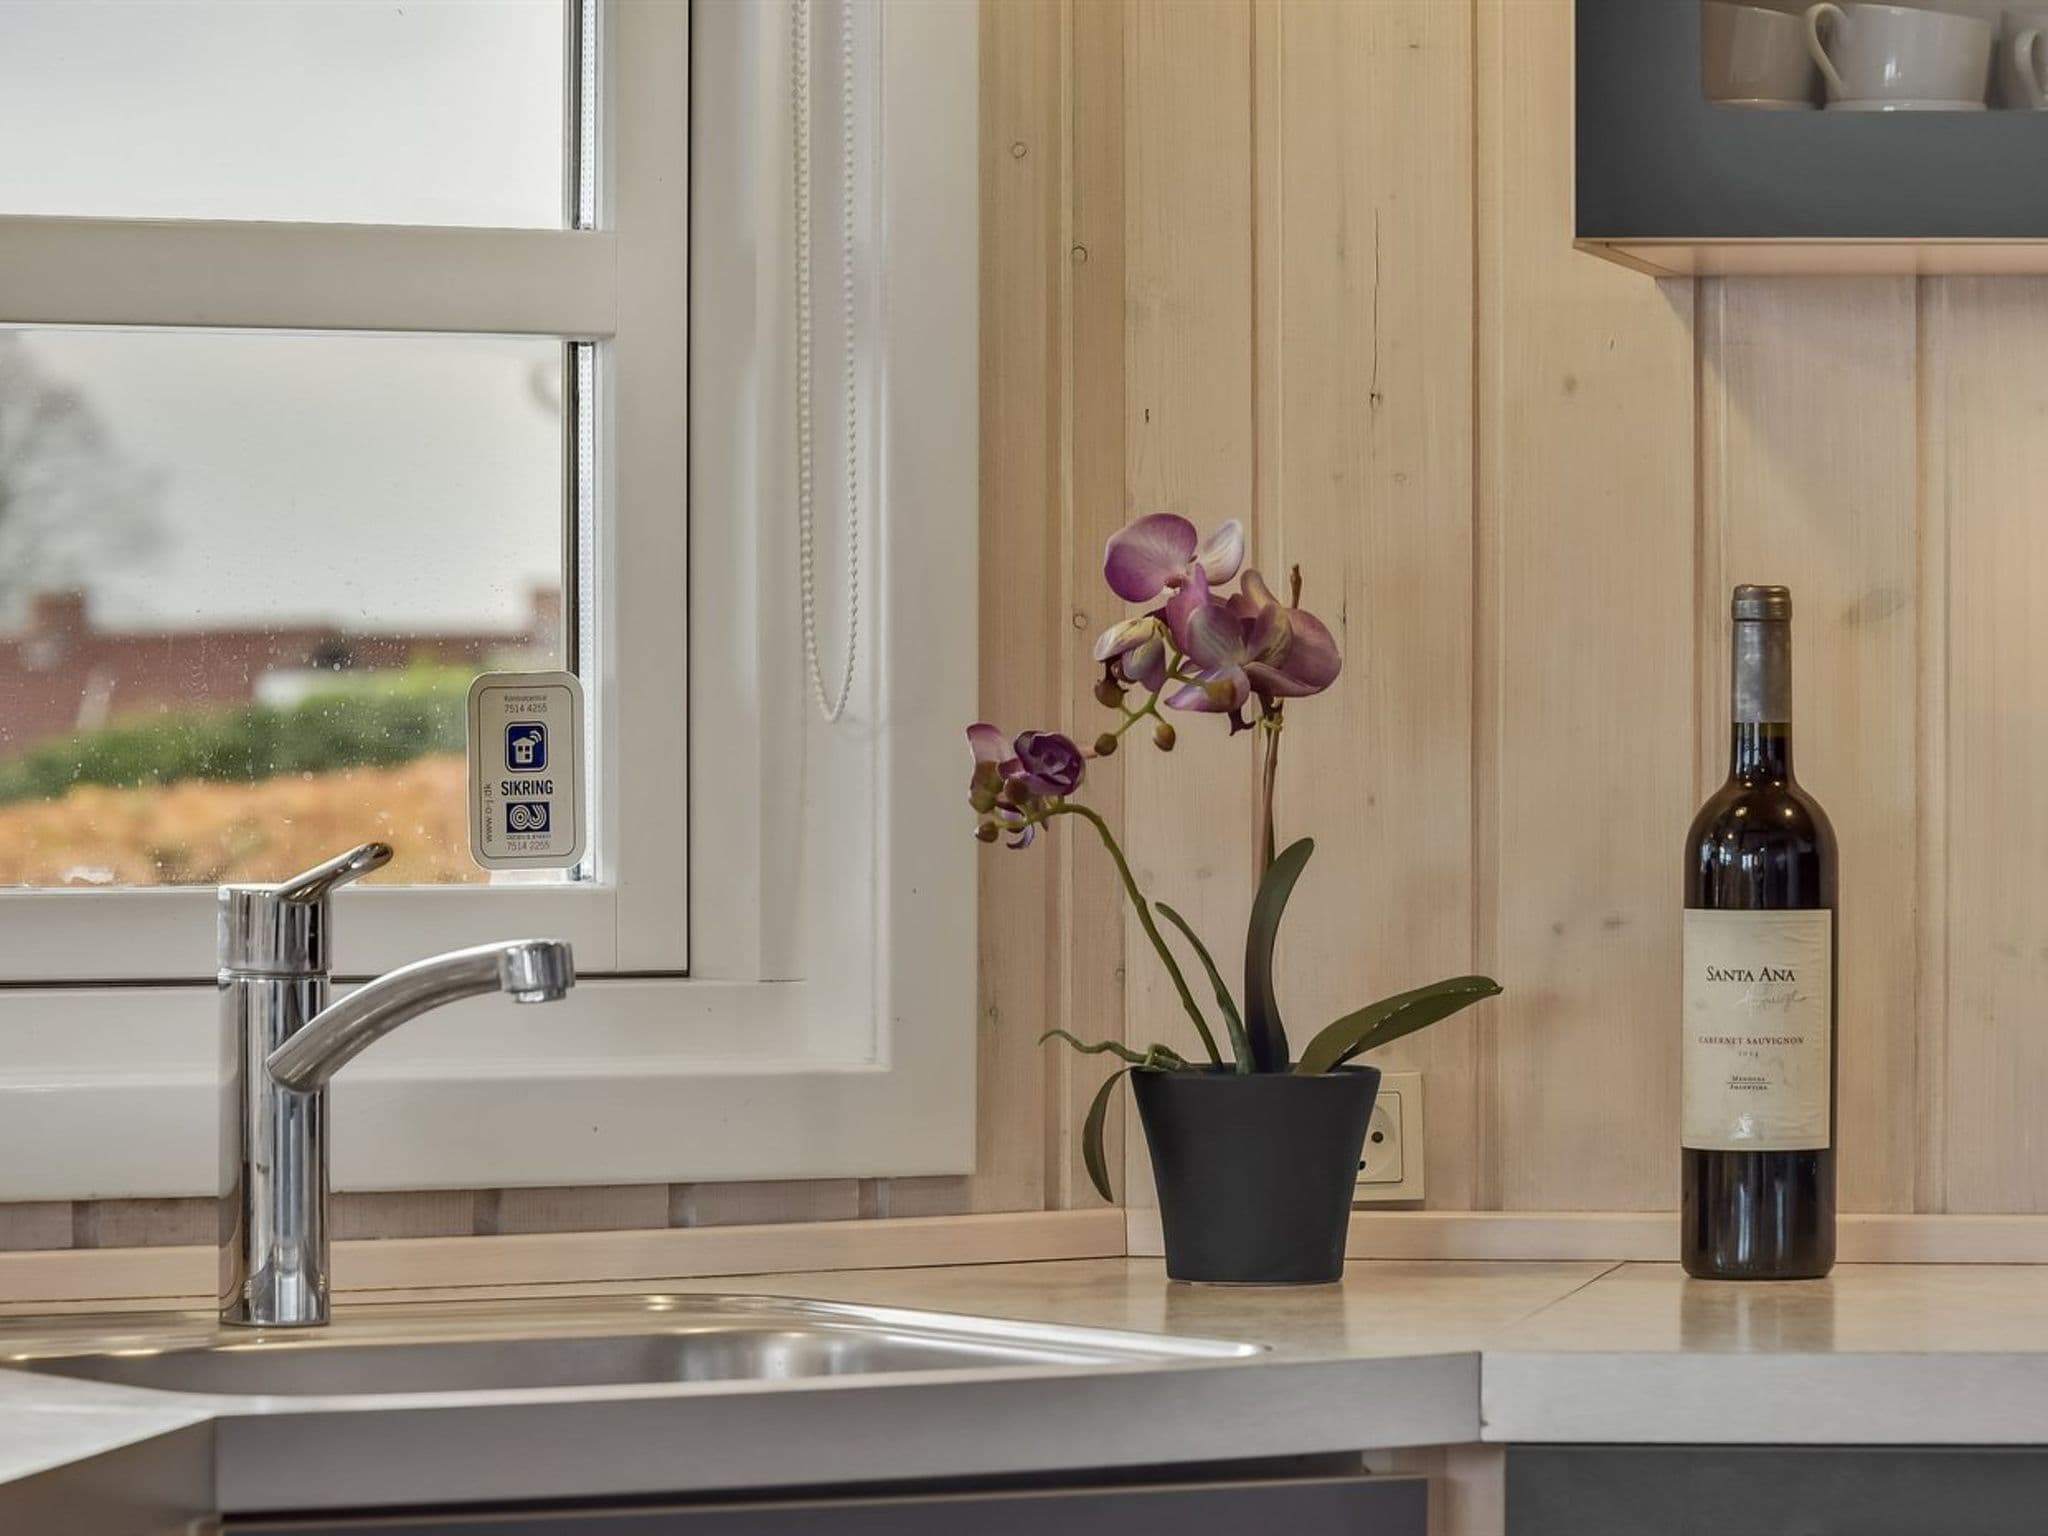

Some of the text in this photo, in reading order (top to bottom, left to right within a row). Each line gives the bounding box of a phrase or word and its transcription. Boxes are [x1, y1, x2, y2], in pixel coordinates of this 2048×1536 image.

[501, 780, 553, 796] SIKRING
[1698, 1036, 1804, 1045] CABERNET SAUVIGNON
